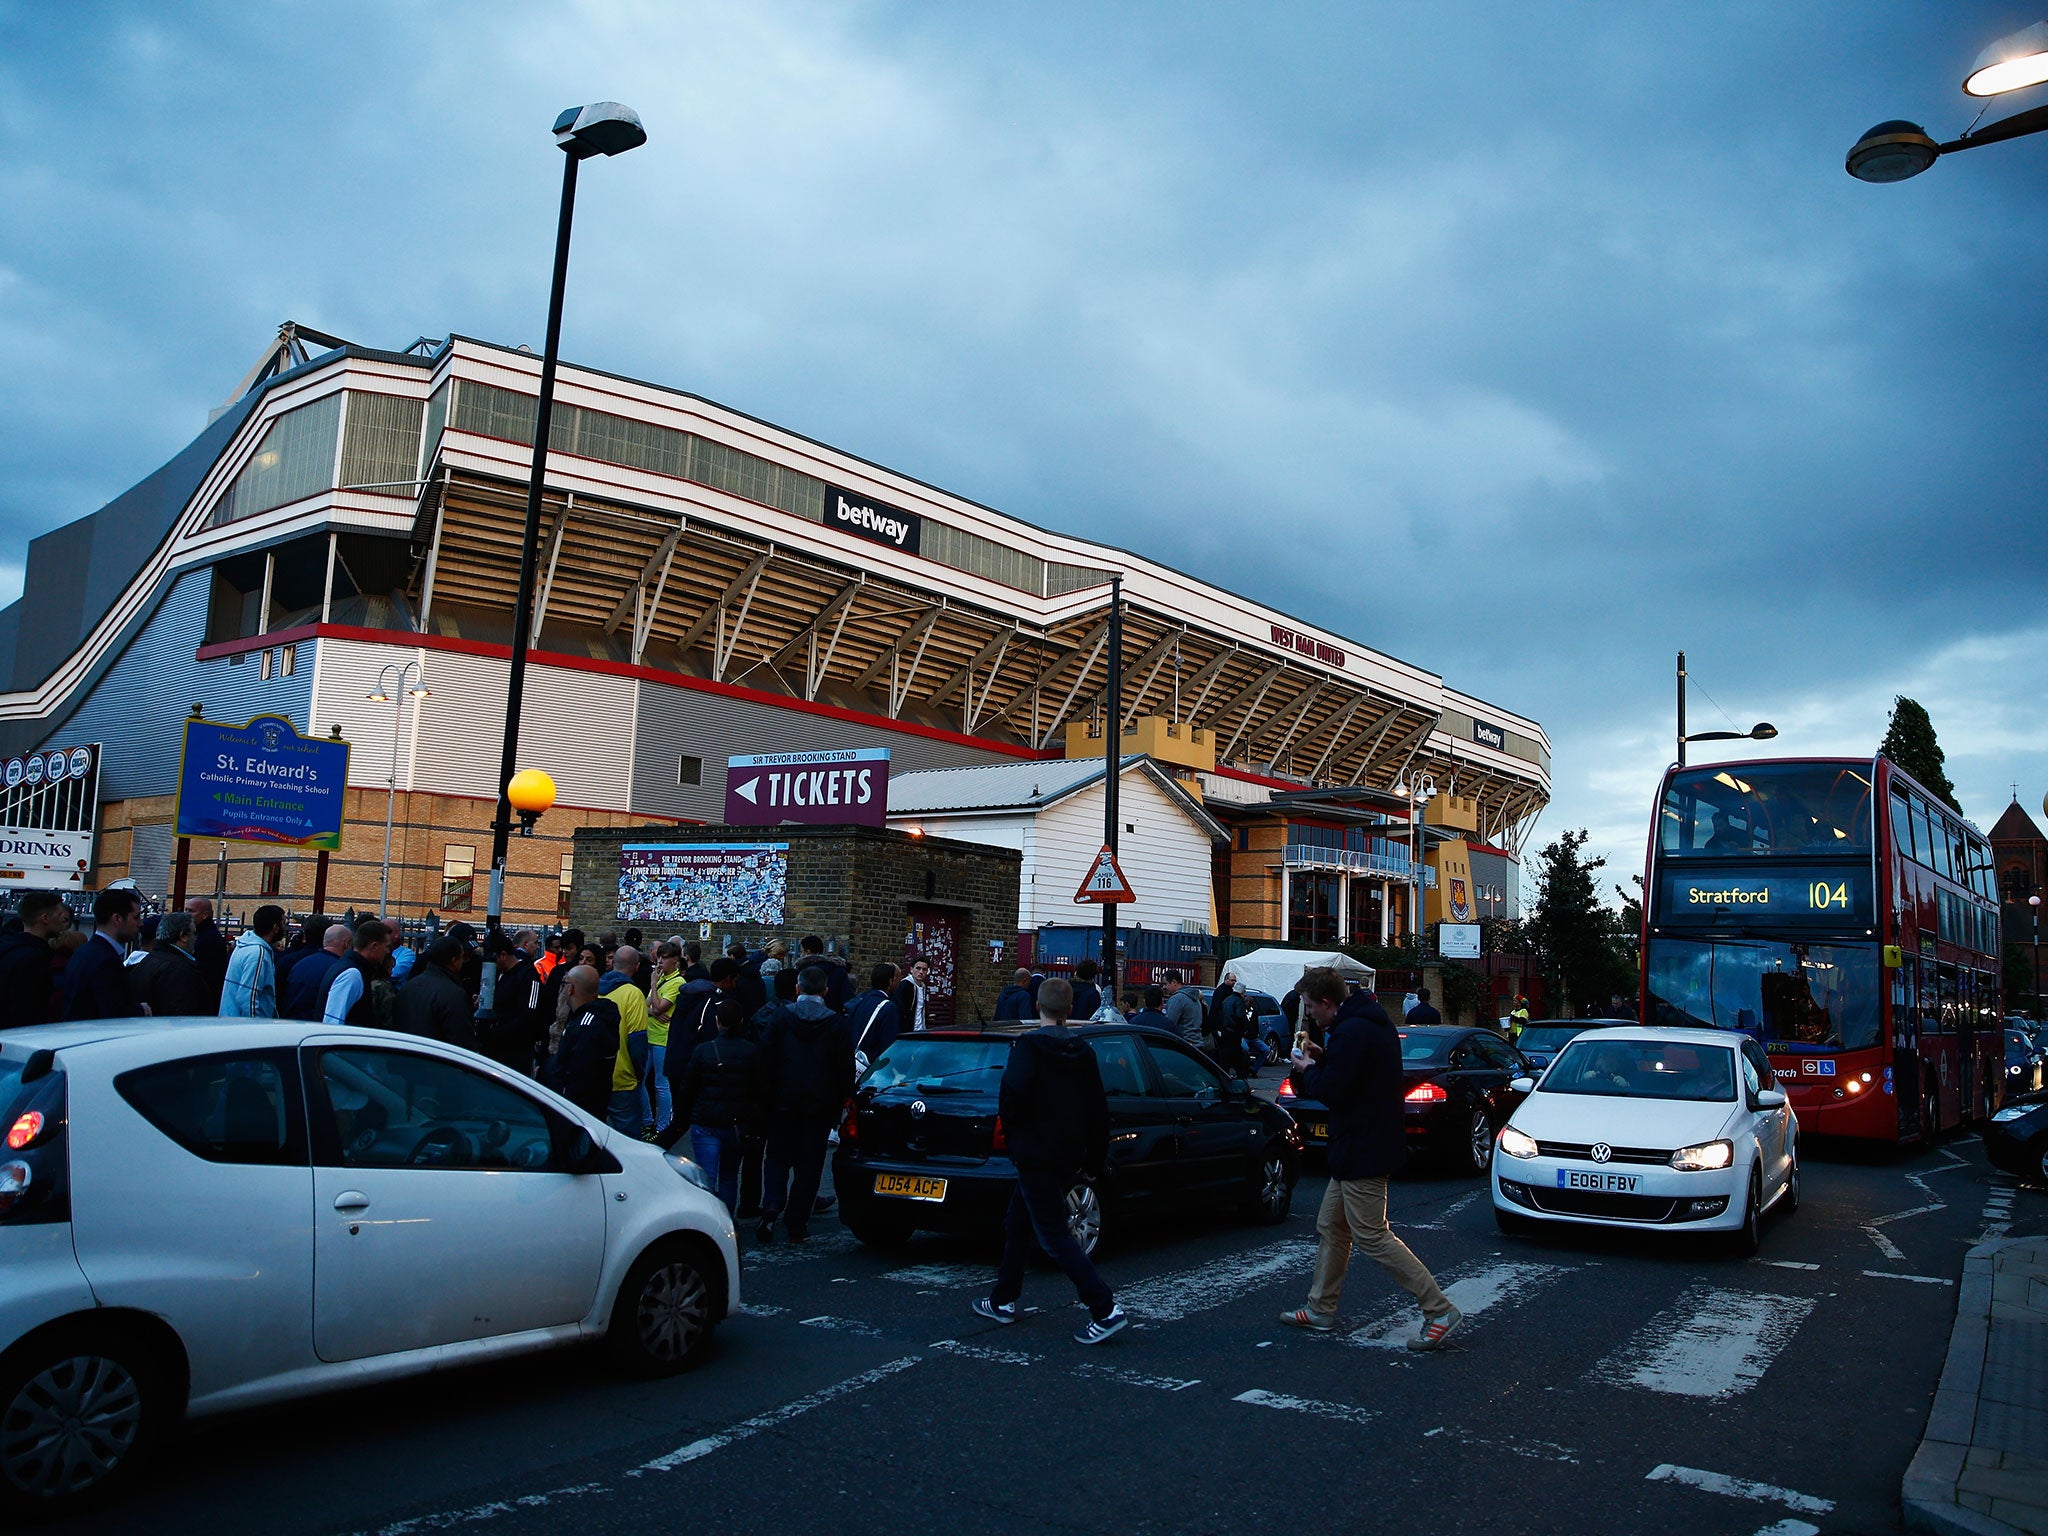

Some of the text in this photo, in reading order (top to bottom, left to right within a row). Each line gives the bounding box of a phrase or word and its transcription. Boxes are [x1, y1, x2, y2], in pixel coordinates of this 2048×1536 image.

[837, 496, 909, 544] betway
[1271, 625, 1345, 667] WEST HAM UNITED
[1478, 725, 1500, 748] betway
[217, 754, 318, 780] St. Edward's
[752, 752, 856, 764] SIR TREVOR BROOKING STAND
[200, 772, 330, 794] Catholic Primary Teaching School
[769, 769, 872, 806] TICKETS
[224, 793, 304, 811] Main Entrance
[223, 810, 302, 826] Pupils Entrance Only
[0, 840, 72, 858] DRINKS
[672, 856, 692, 864] TREVOR
[693, 856, 722, 864] BROOKING
[724, 856, 741, 864] STAND
[632, 867, 649, 875] LOWER
[650, 867, 660, 875] TIER
[1097, 878, 1112, 888] 116
[1689, 882, 1848, 909] Stratford 104
[880, 1176, 940, 1194] LD54 ACF
[1608, 1176, 1636, 1191] FBV
